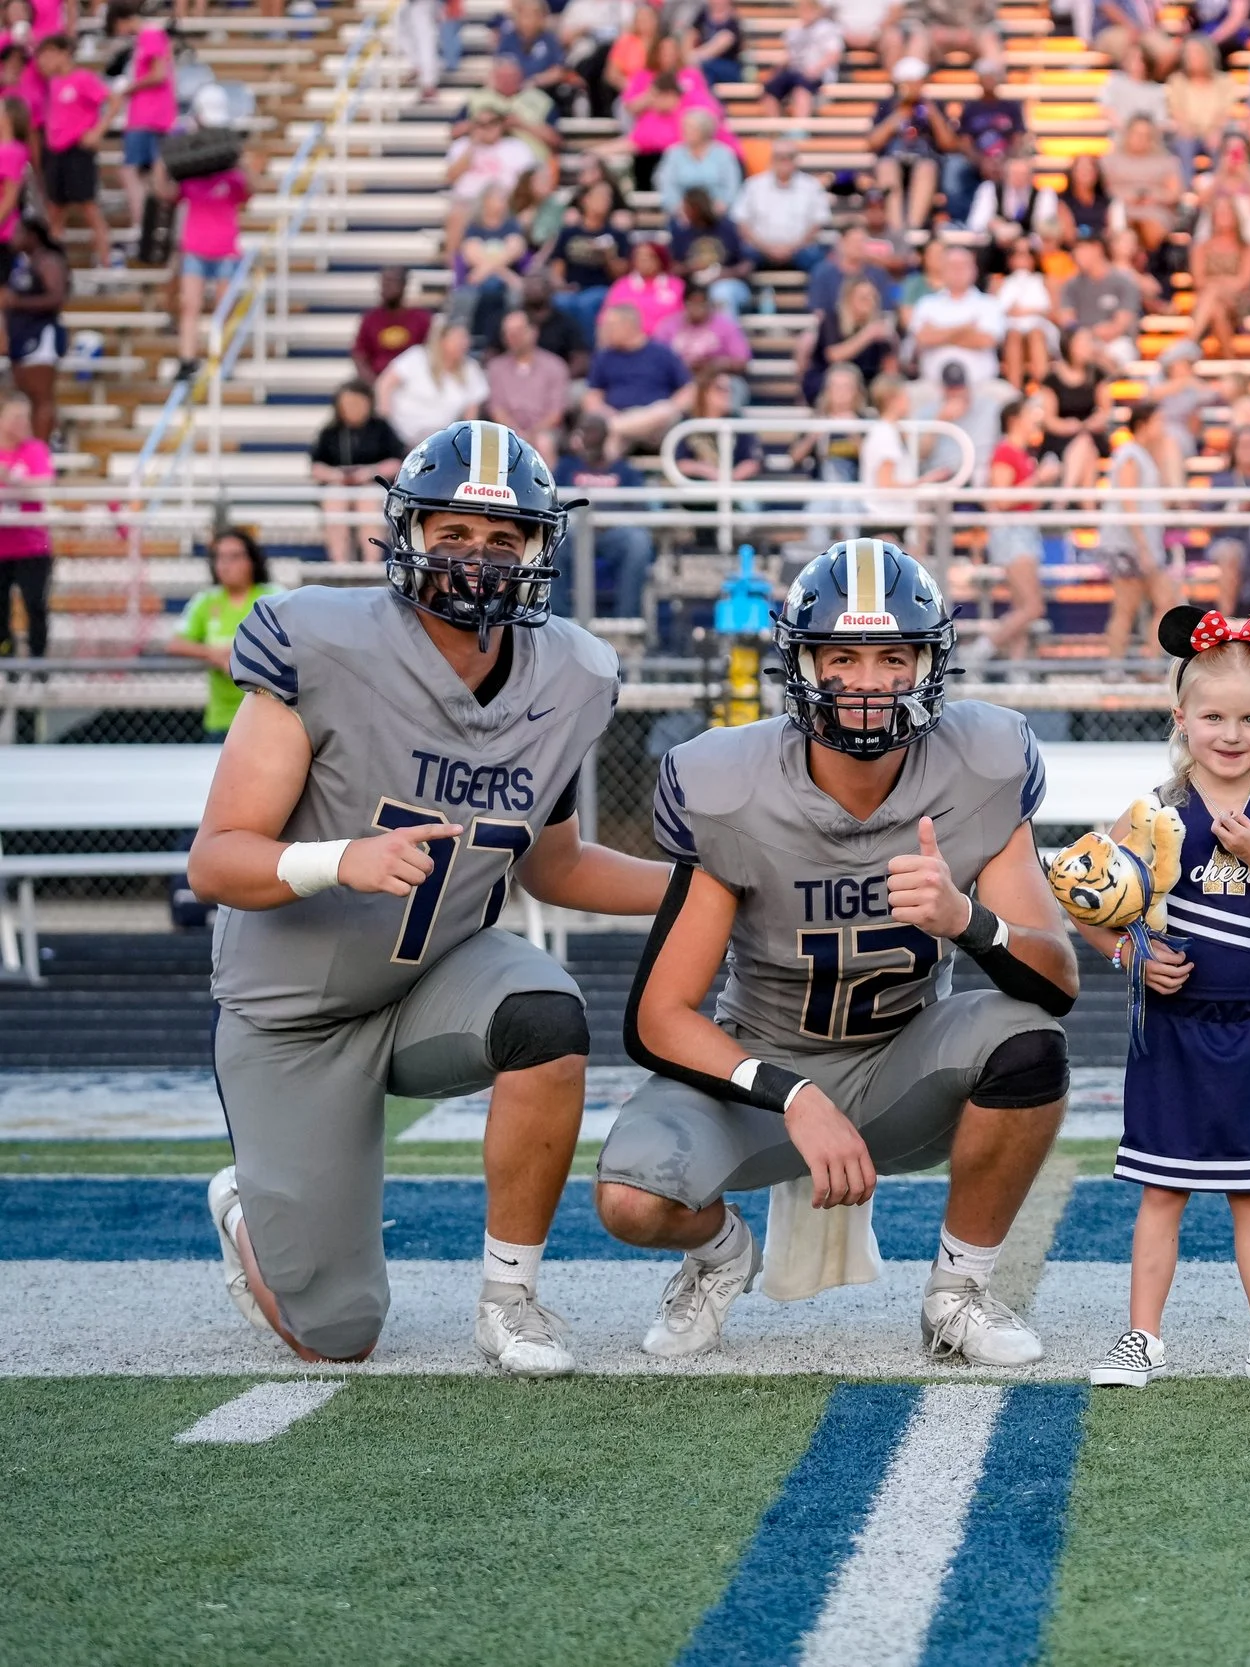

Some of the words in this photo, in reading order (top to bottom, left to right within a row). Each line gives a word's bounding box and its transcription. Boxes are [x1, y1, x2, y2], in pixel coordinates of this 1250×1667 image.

[463, 484, 510, 499] Riddell
[843, 615, 890, 626] Riddell
[412, 750, 534, 812] TIGERS
[794, 873, 893, 922] TIGE
[797, 921, 943, 1040] 12
